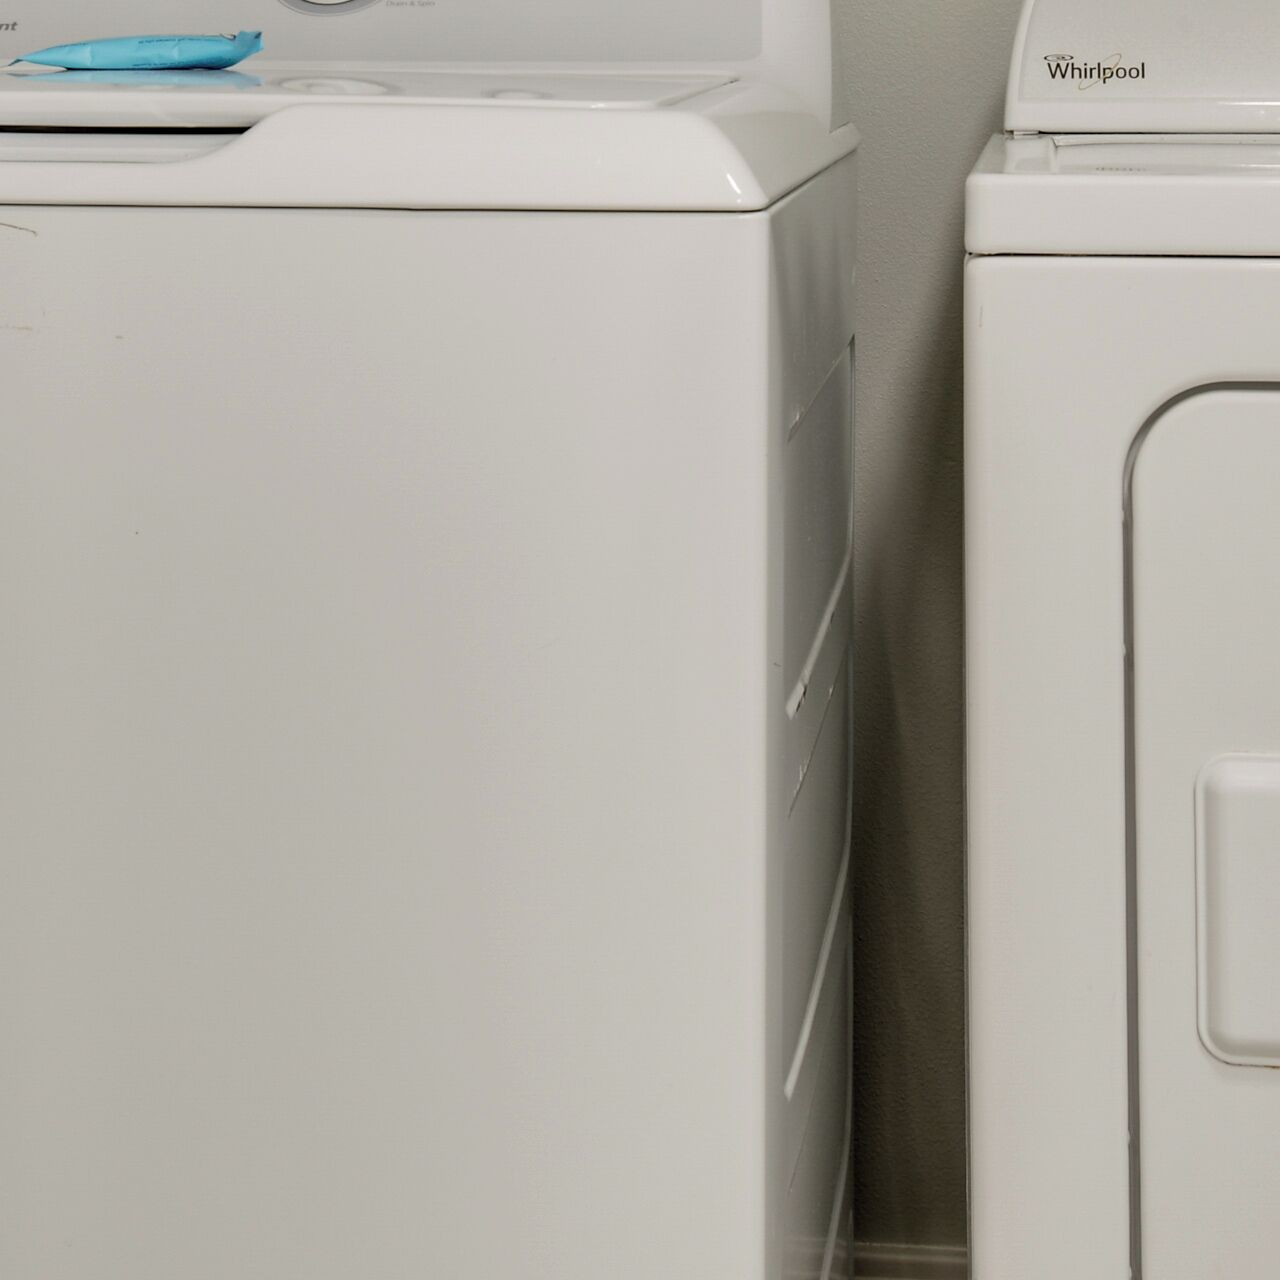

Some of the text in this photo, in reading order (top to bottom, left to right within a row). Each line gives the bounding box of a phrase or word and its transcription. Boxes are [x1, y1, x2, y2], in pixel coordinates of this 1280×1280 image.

[385, 0, 409, 7] Drain
[417, 0, 436, 8] Spin
[1047, 62, 1145, 84] Whirlpool
